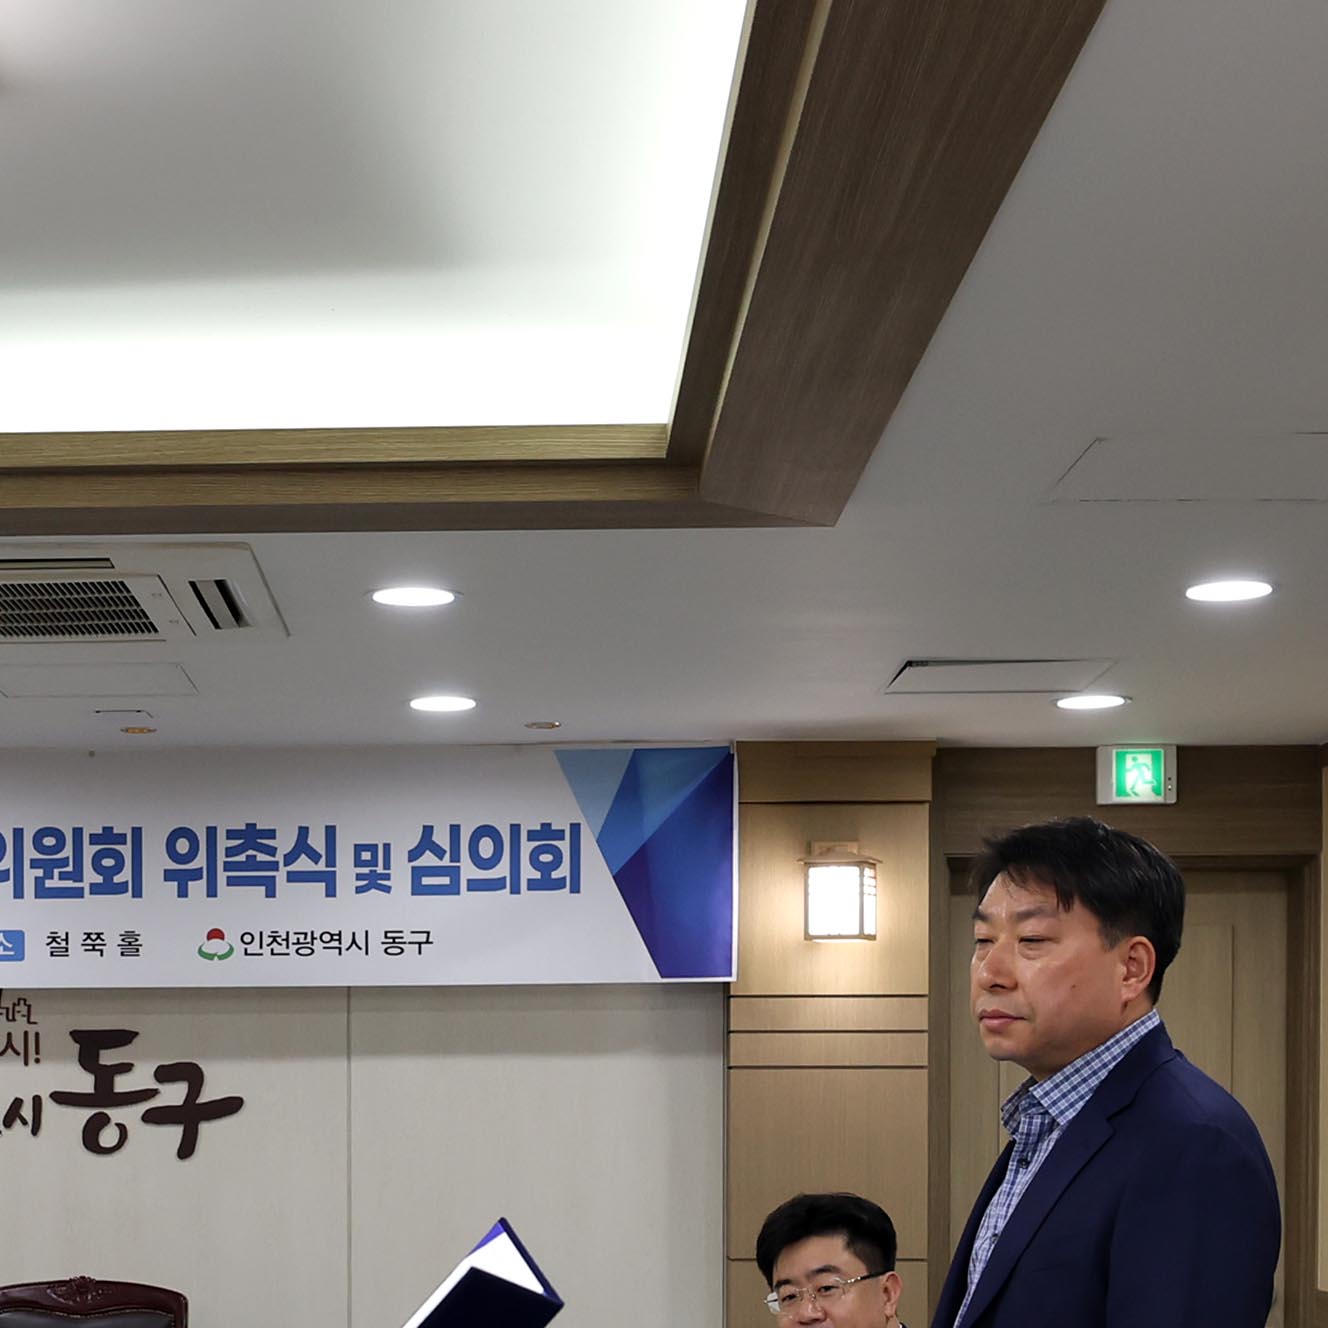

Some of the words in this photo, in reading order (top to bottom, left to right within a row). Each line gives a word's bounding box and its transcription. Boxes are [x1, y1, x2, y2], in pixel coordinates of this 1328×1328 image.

[163, 823, 337, 899] 위촉식
[353, 842, 392, 895] 및
[408, 822, 581, 896] 심의회
[239, 930, 370, 956] 인천광역시
[380, 930, 434, 956] 동구
[49, 1029, 245, 1160] 동구
